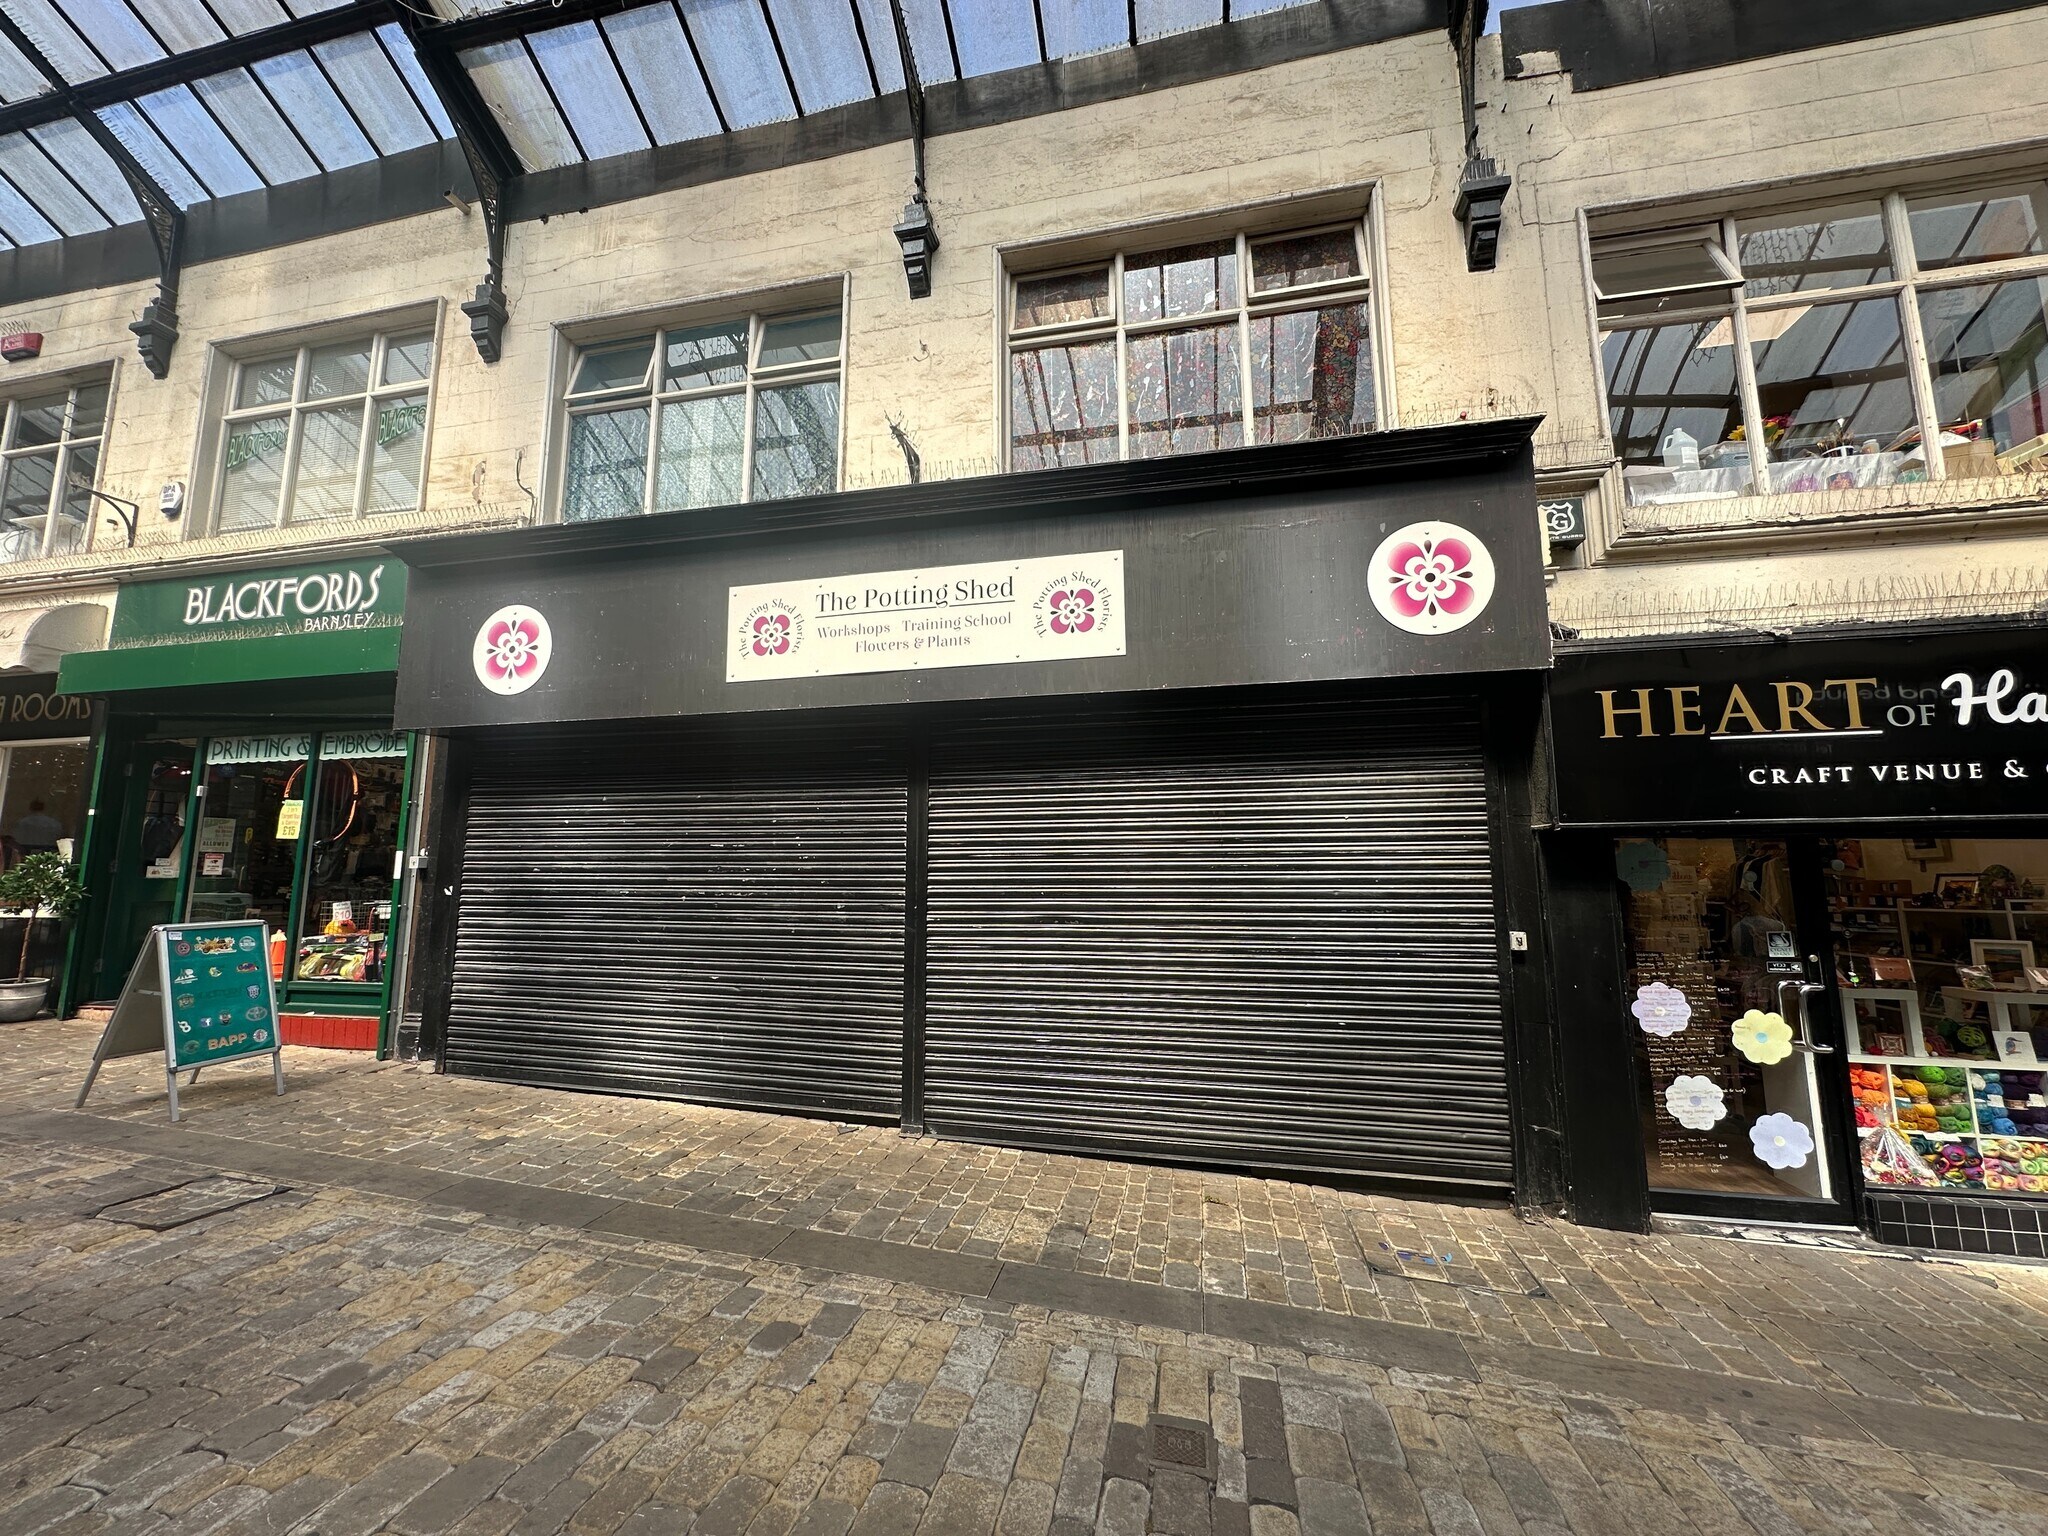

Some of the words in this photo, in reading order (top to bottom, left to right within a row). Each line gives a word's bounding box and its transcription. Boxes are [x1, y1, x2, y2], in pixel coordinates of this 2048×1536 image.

[378, 405, 427, 445] BLACKFO
[1033, 576, 1068, 610] Potting
[1071, 571, 1101, 588] Shed
[183, 564, 385, 626] BLACKFORDS
[772, 598, 797, 614] Shed
[815, 592, 857, 612] The
[864, 583, 949, 608] Potting
[955, 575, 1014, 601] Shed
[304, 611, 375, 632] BARNSLEY
[739, 603, 769, 633] Potting
[1097, 587, 1112, 633] Florists
[791, 613, 805, 655] Florists
[817, 623, 891, 639] Workshops
[902, 617, 961, 632] Training
[964, 612, 1012, 628] School
[1033, 613, 1047, 638] The
[738, 638, 750, 660] The
[856, 638, 909, 653] Flowers
[914, 637, 924, 649] &
[928, 635, 971, 648] Plants
[1594, 677, 1878, 739] HEART
[1886, 704, 1936, 727] OF
[1941, 669, 2048, 726] Ha
[211, 737, 291, 760] PRINTING
[323, 733, 407, 756] EMBROIDE
[1749, 765, 1854, 785] CRAFT
[1869, 763, 1983, 782] VENUE
[2003, 759, 2029, 779] &
[208, 1033, 248, 1051] BAPP
